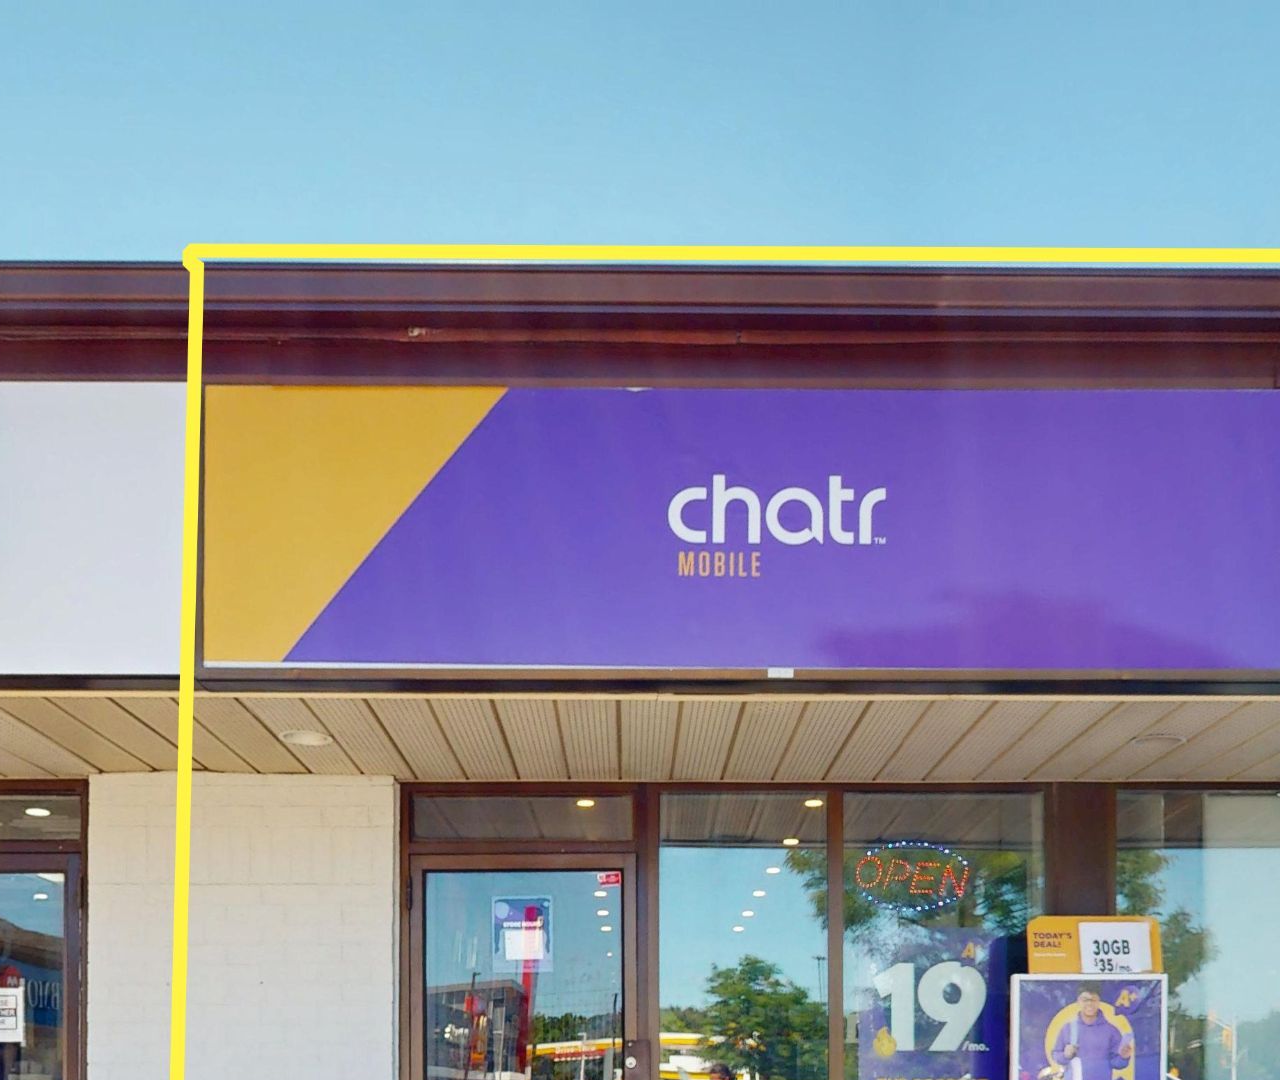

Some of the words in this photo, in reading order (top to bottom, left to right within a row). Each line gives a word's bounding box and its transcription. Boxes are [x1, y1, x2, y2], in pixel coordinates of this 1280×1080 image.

[667, 474, 887, 546] chatr
[677, 550, 762, 578] MOBILE
[854, 855, 970, 898] OPEN
[1033, 932, 1072, 940] TODAY'S
[1033, 941, 1062, 949] DEAL!
[1093, 940, 1131, 956] 30GB
